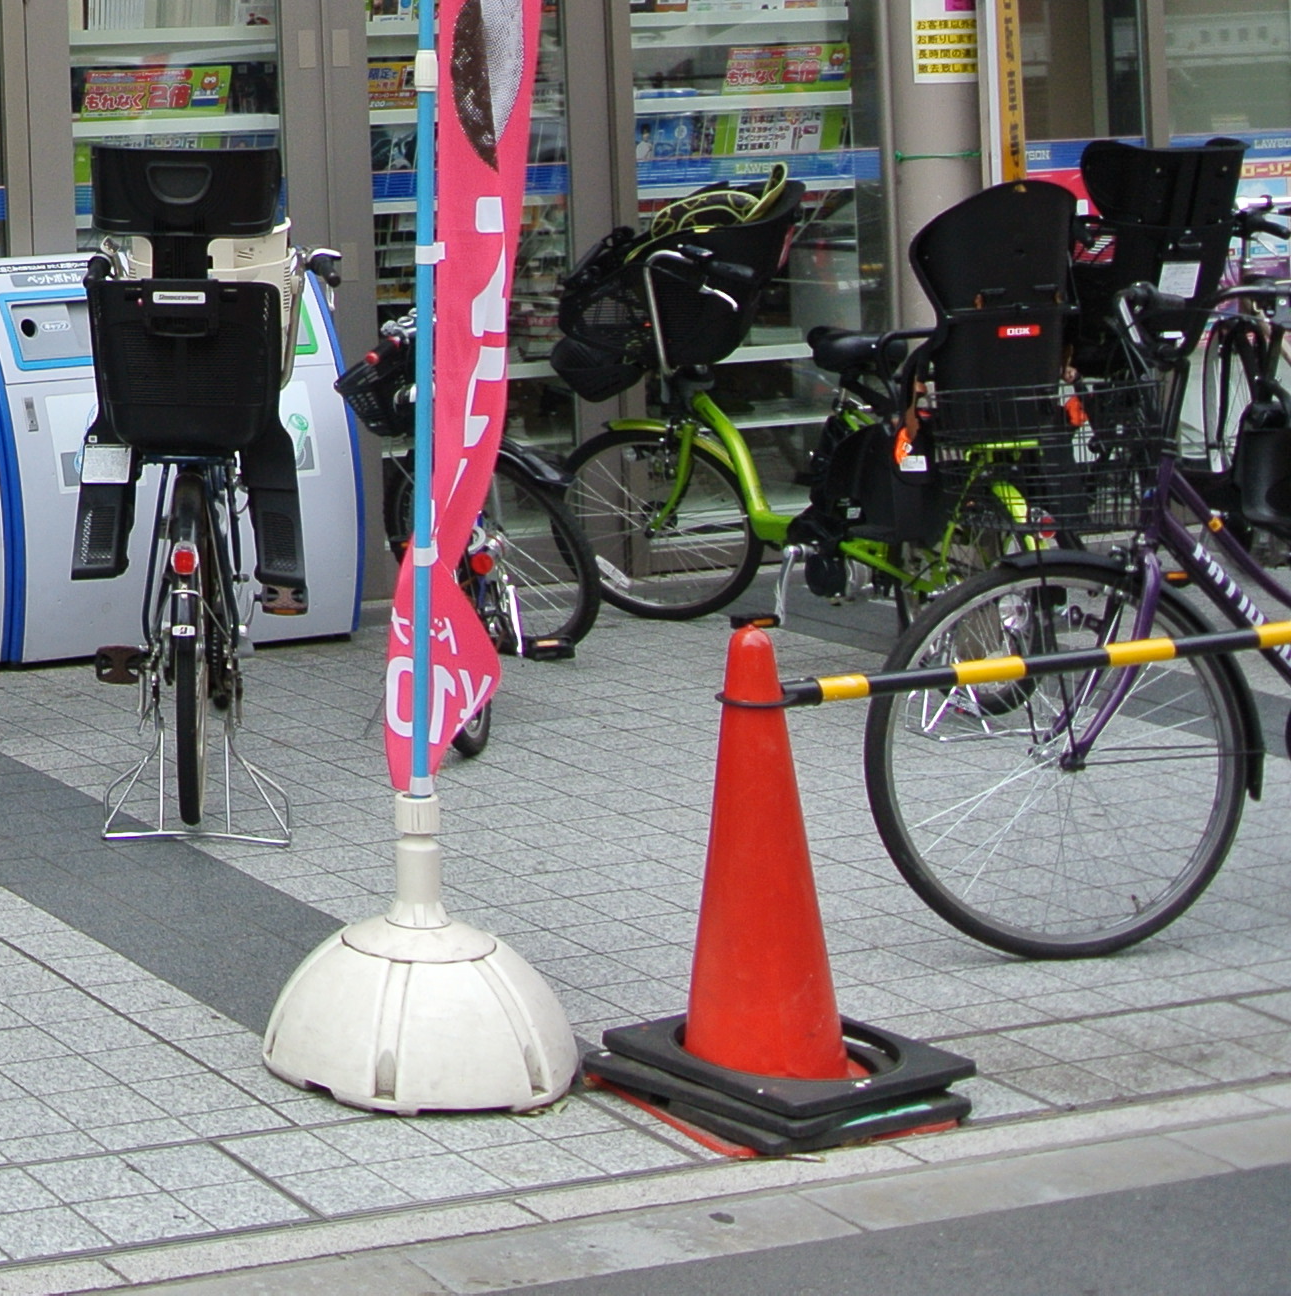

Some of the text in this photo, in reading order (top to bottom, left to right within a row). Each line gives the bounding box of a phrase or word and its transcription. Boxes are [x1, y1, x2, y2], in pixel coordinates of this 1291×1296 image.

[27, 273, 81, 284] ペットボトル
